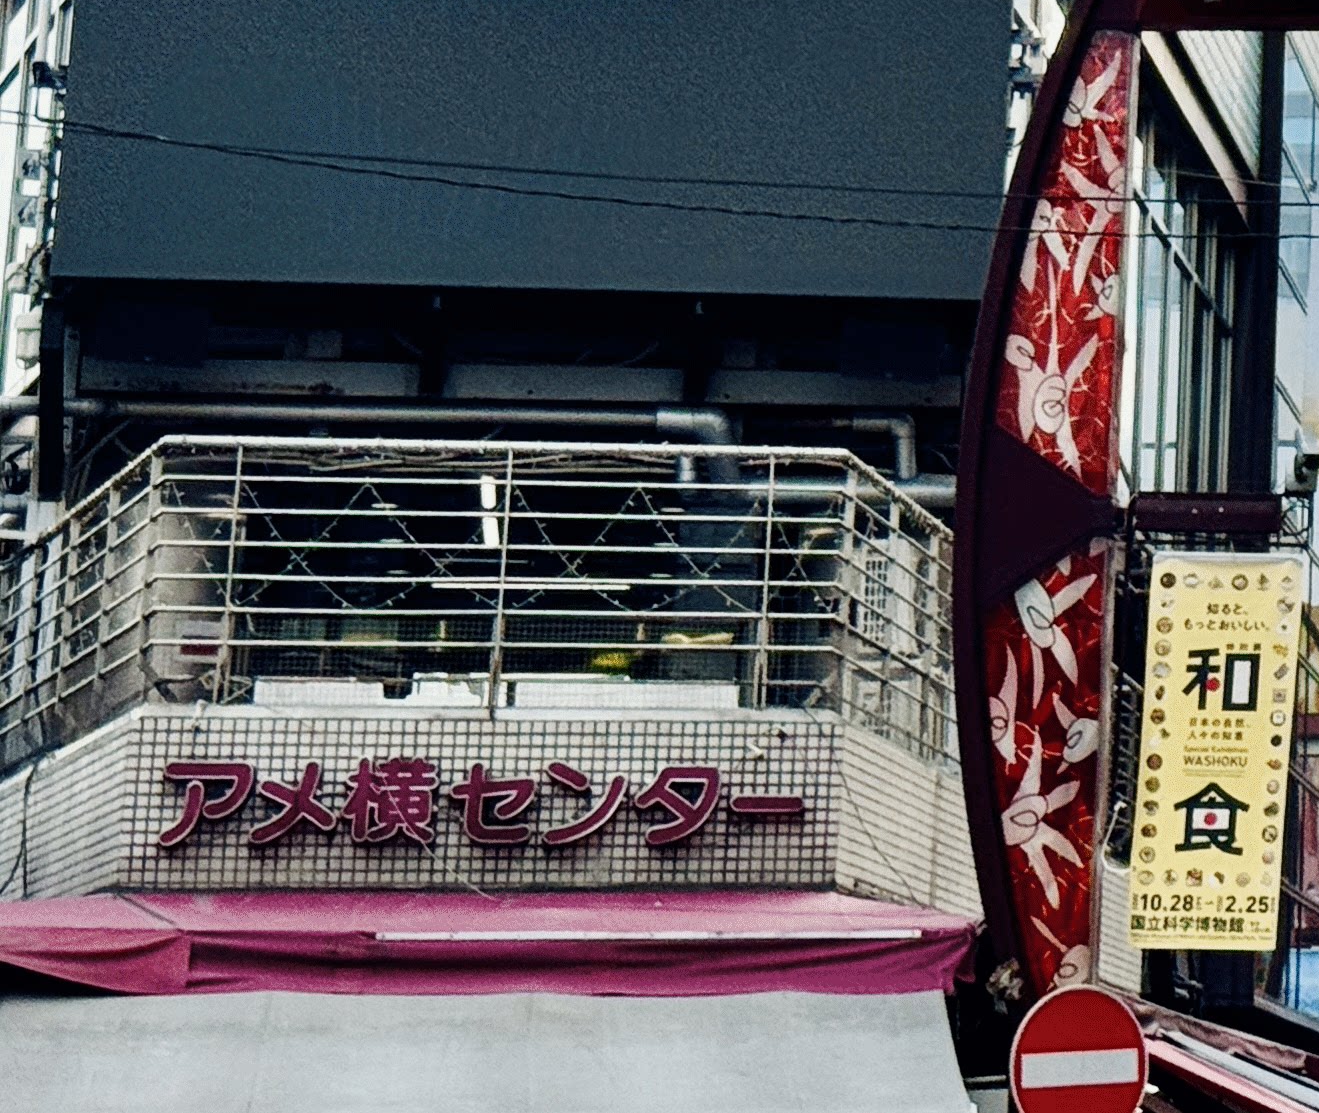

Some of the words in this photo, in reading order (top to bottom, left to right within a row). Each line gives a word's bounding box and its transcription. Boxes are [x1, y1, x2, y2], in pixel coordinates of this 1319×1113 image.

[1181, 647, 1261, 712] 和
[1183, 755, 1248, 767] WASHOKU
[157, 756, 804, 849] アメ横センター
[1174, 782, 1250, 856] 食
[1140, 894, 1195, 912] 10.28
[1225, 895, 1269, 914] 2.25
